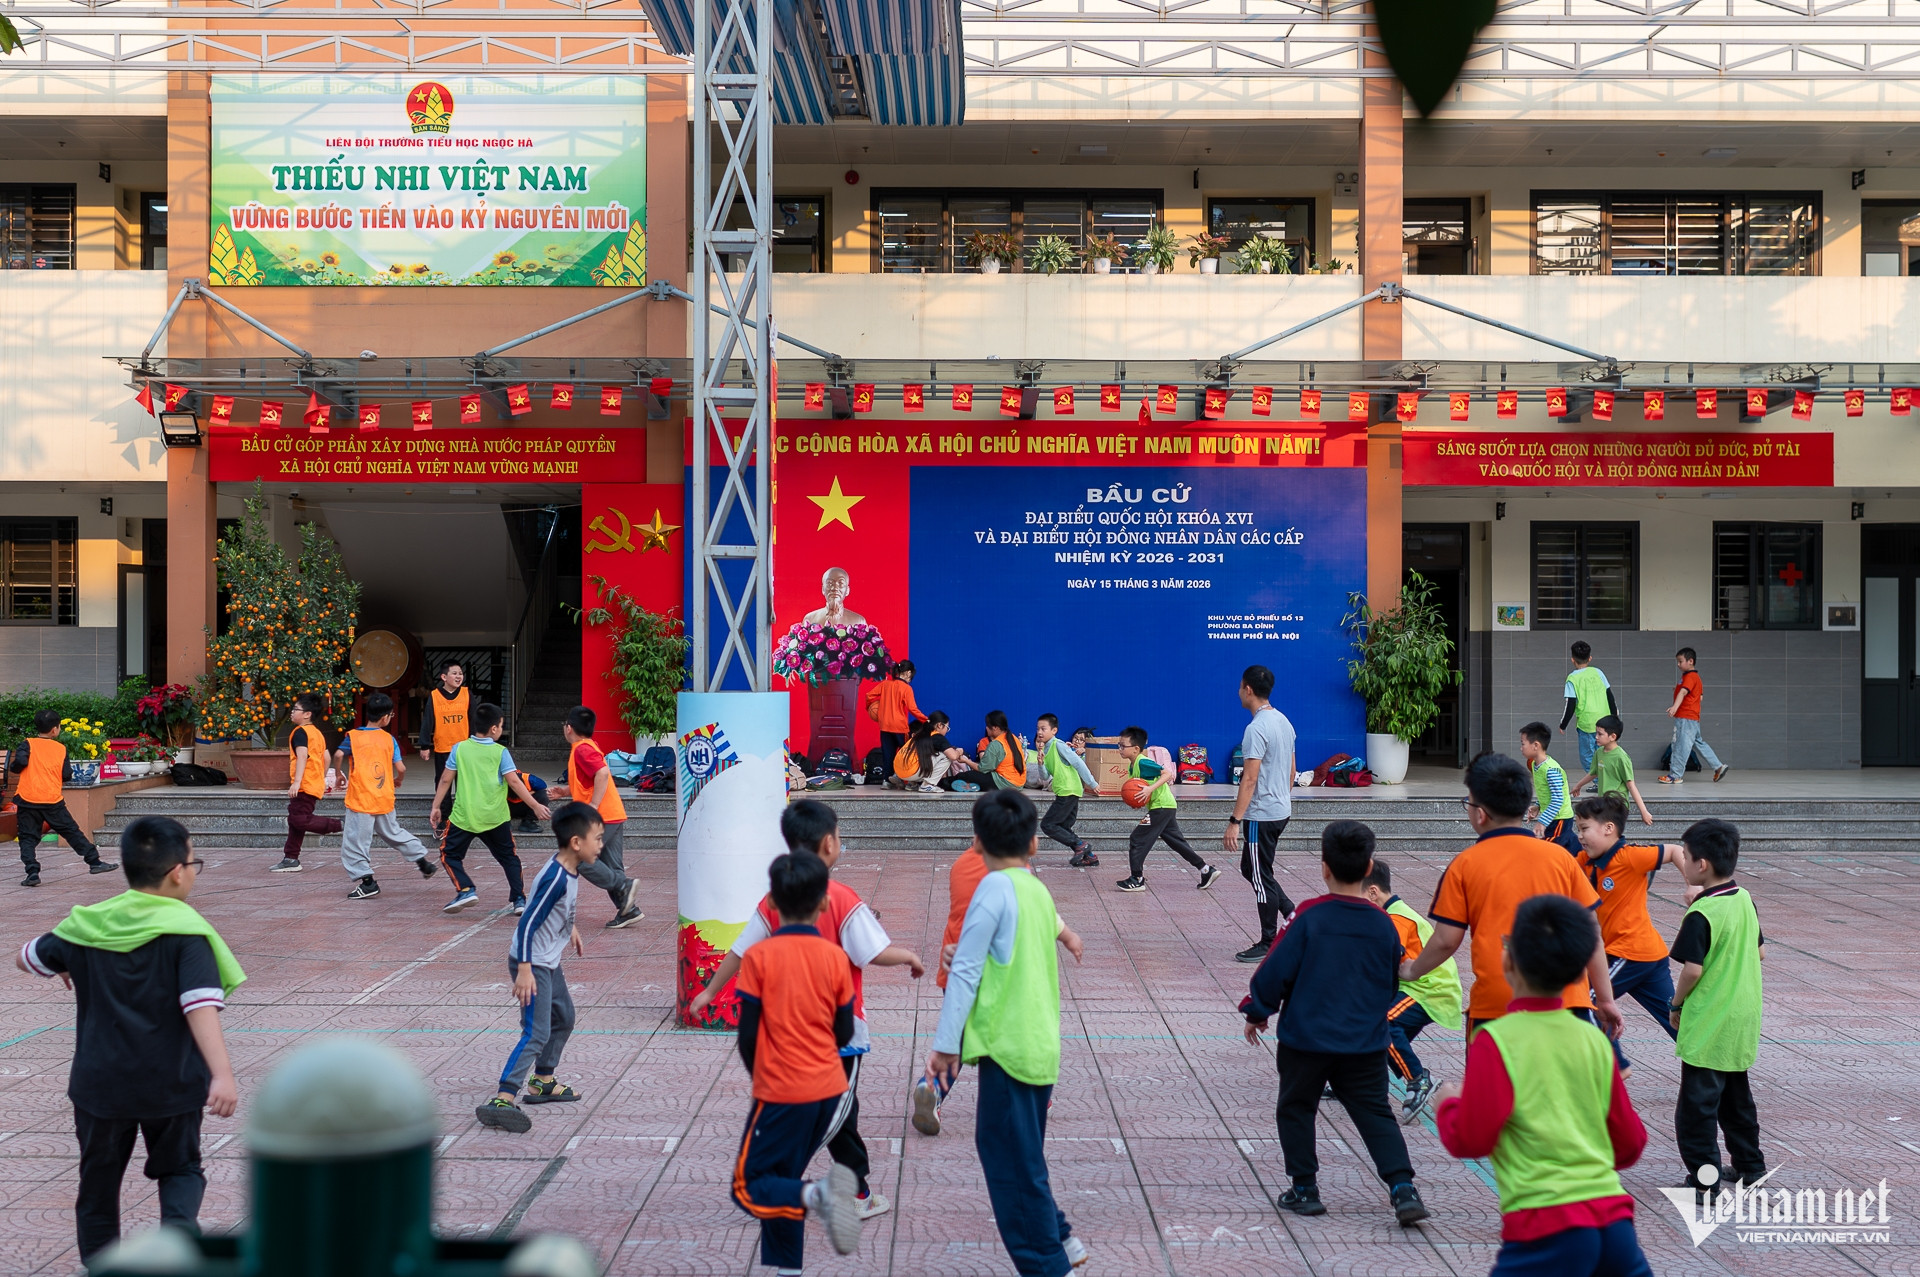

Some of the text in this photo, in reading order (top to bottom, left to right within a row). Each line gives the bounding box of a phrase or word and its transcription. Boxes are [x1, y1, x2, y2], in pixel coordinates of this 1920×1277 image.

[326, 136, 533, 149] LIÊN ĐỘI TRƯỜNG TIỂU HỌC NGỌC HÀ
[272, 154, 587, 197] THIẾU NHI VIỆT NAM
[232, 200, 628, 230] VỮNG BƯỚC TIẾN VÀO KỶ NGUYÊN MỚI
[242, 433, 617, 456] BẦU CỬ GÓP PHẦN XÂY DỰNG NHÀ NƯỚC PHÁP QUYỀN
[796, 432, 851, 457] CỘNG
[859, 431, 899, 453] HÒA
[906, 432, 932, 453] XÃ
[940, 433, 972, 457] HỘI
[979, 430, 1020, 454] CHỦ
[1028, 432, 1089, 454] NGHĨA
[1096, 434, 1139, 458] VIỆT
[1145, 437, 1191, 454] NAM
[1199, 434, 1258, 454] MUÔN
[1265, 434, 1320, 455] NĂM!
[1437, 437, 1800, 460] SÁNG SUỐT LỰA CHỌN NHỮNG NGƯỜI ĐỦ ĐỨC, ĐỦ TÀI
[280, 456, 579, 477] XÃ HỘI CHỦ NGHĨA VIỆT NAM VỮNG MẠNH!
[1479, 458, 1760, 480] VÀO QUỐC HỘI VÀ HỘI ĐỒNG NHÂN DÂN!
[1087, 482, 1193, 503] BẦU CỬ
[1025, 505, 1253, 528] ĐẠI BIỂU QUỐC HỘI KHÓA XVI
[974, 524, 1304, 548] VÀ ĐẠI BIỂU HỘI ĐỒNG NHÂN DÂN CÁC CẤP
[1054, 549, 1106, 567] NHIỆM
[1110, 549, 1132, 563] KỲ
[1136, 552, 1175, 564] 2026
[1187, 552, 1225, 564] 2031
[1067, 577, 1211, 589] NGÀY 15 THÁNG 3 NĂM 2026
[1208, 631, 1300, 641] THÀNH PHỐ HÀ NỘI
[443, 715, 464, 725] NTP
[690, 748, 710, 764] NH
